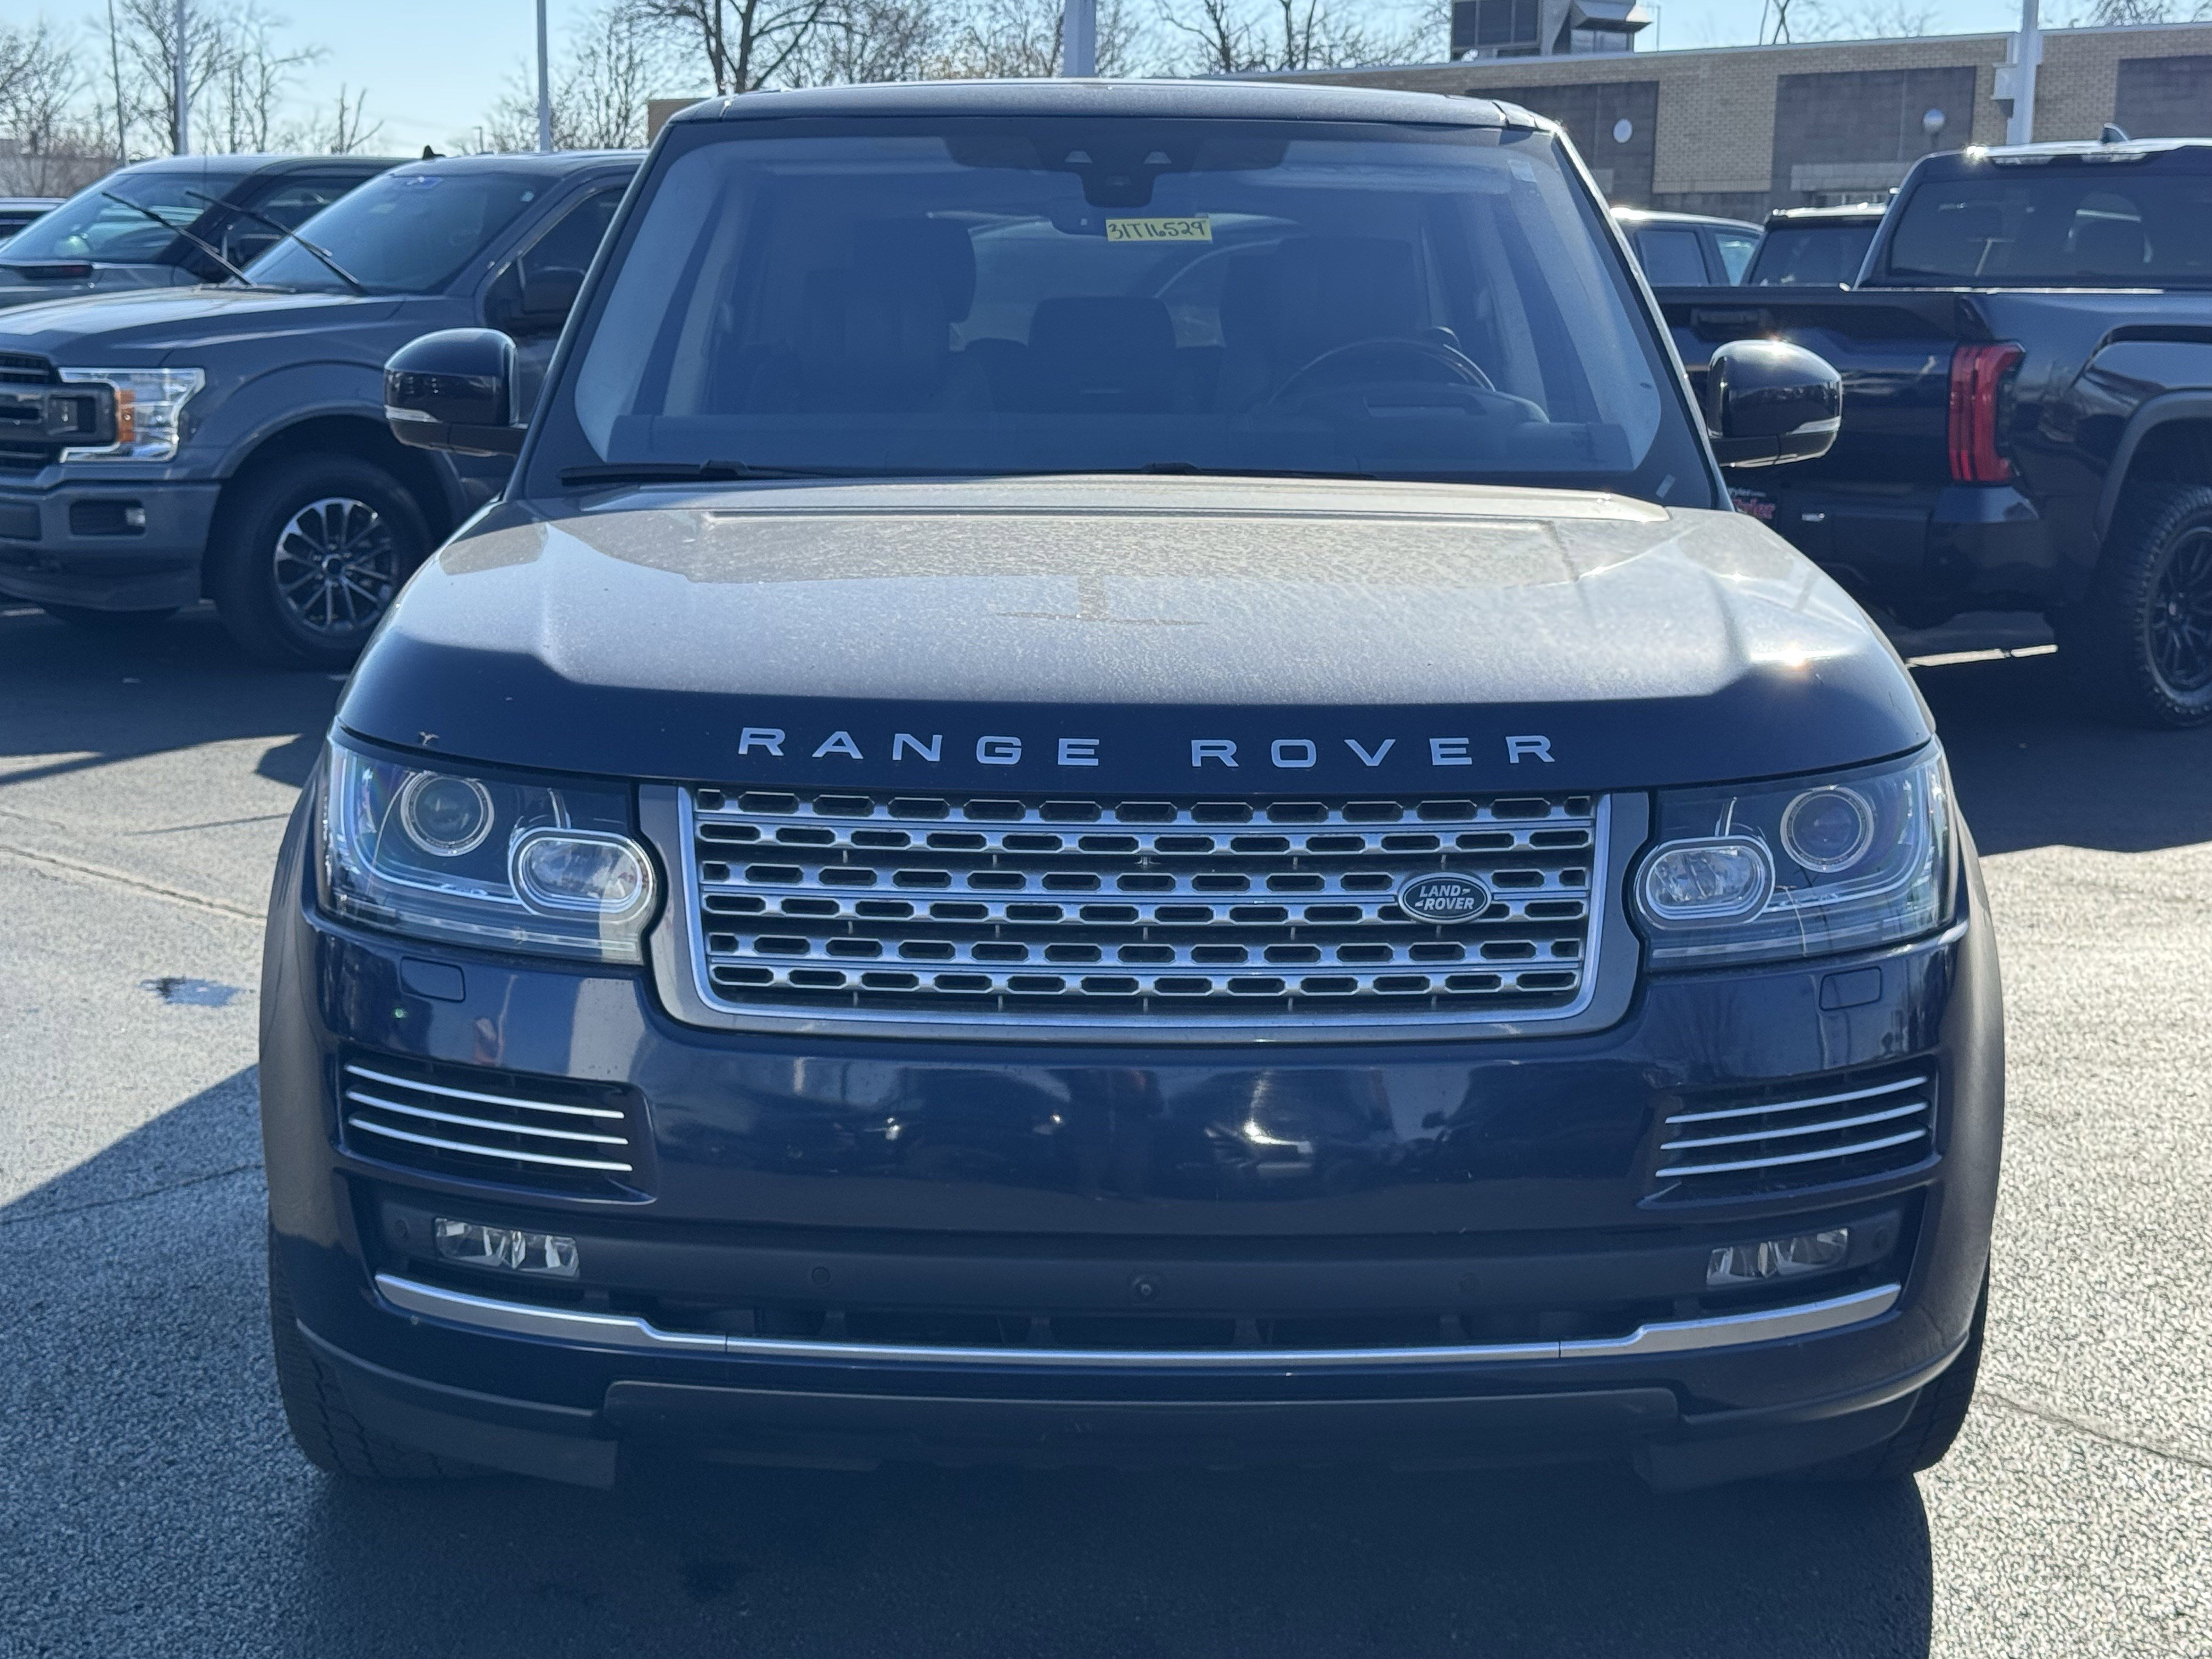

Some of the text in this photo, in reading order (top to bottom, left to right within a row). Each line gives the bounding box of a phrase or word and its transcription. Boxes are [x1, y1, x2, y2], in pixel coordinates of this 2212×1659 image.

[1108, 221, 1206, 240] 31T16529
[738, 727, 1556, 768] RANGE ROVER
[1419, 884, 1462, 898] LAND
[1423, 897, 1475, 911] ROVER
